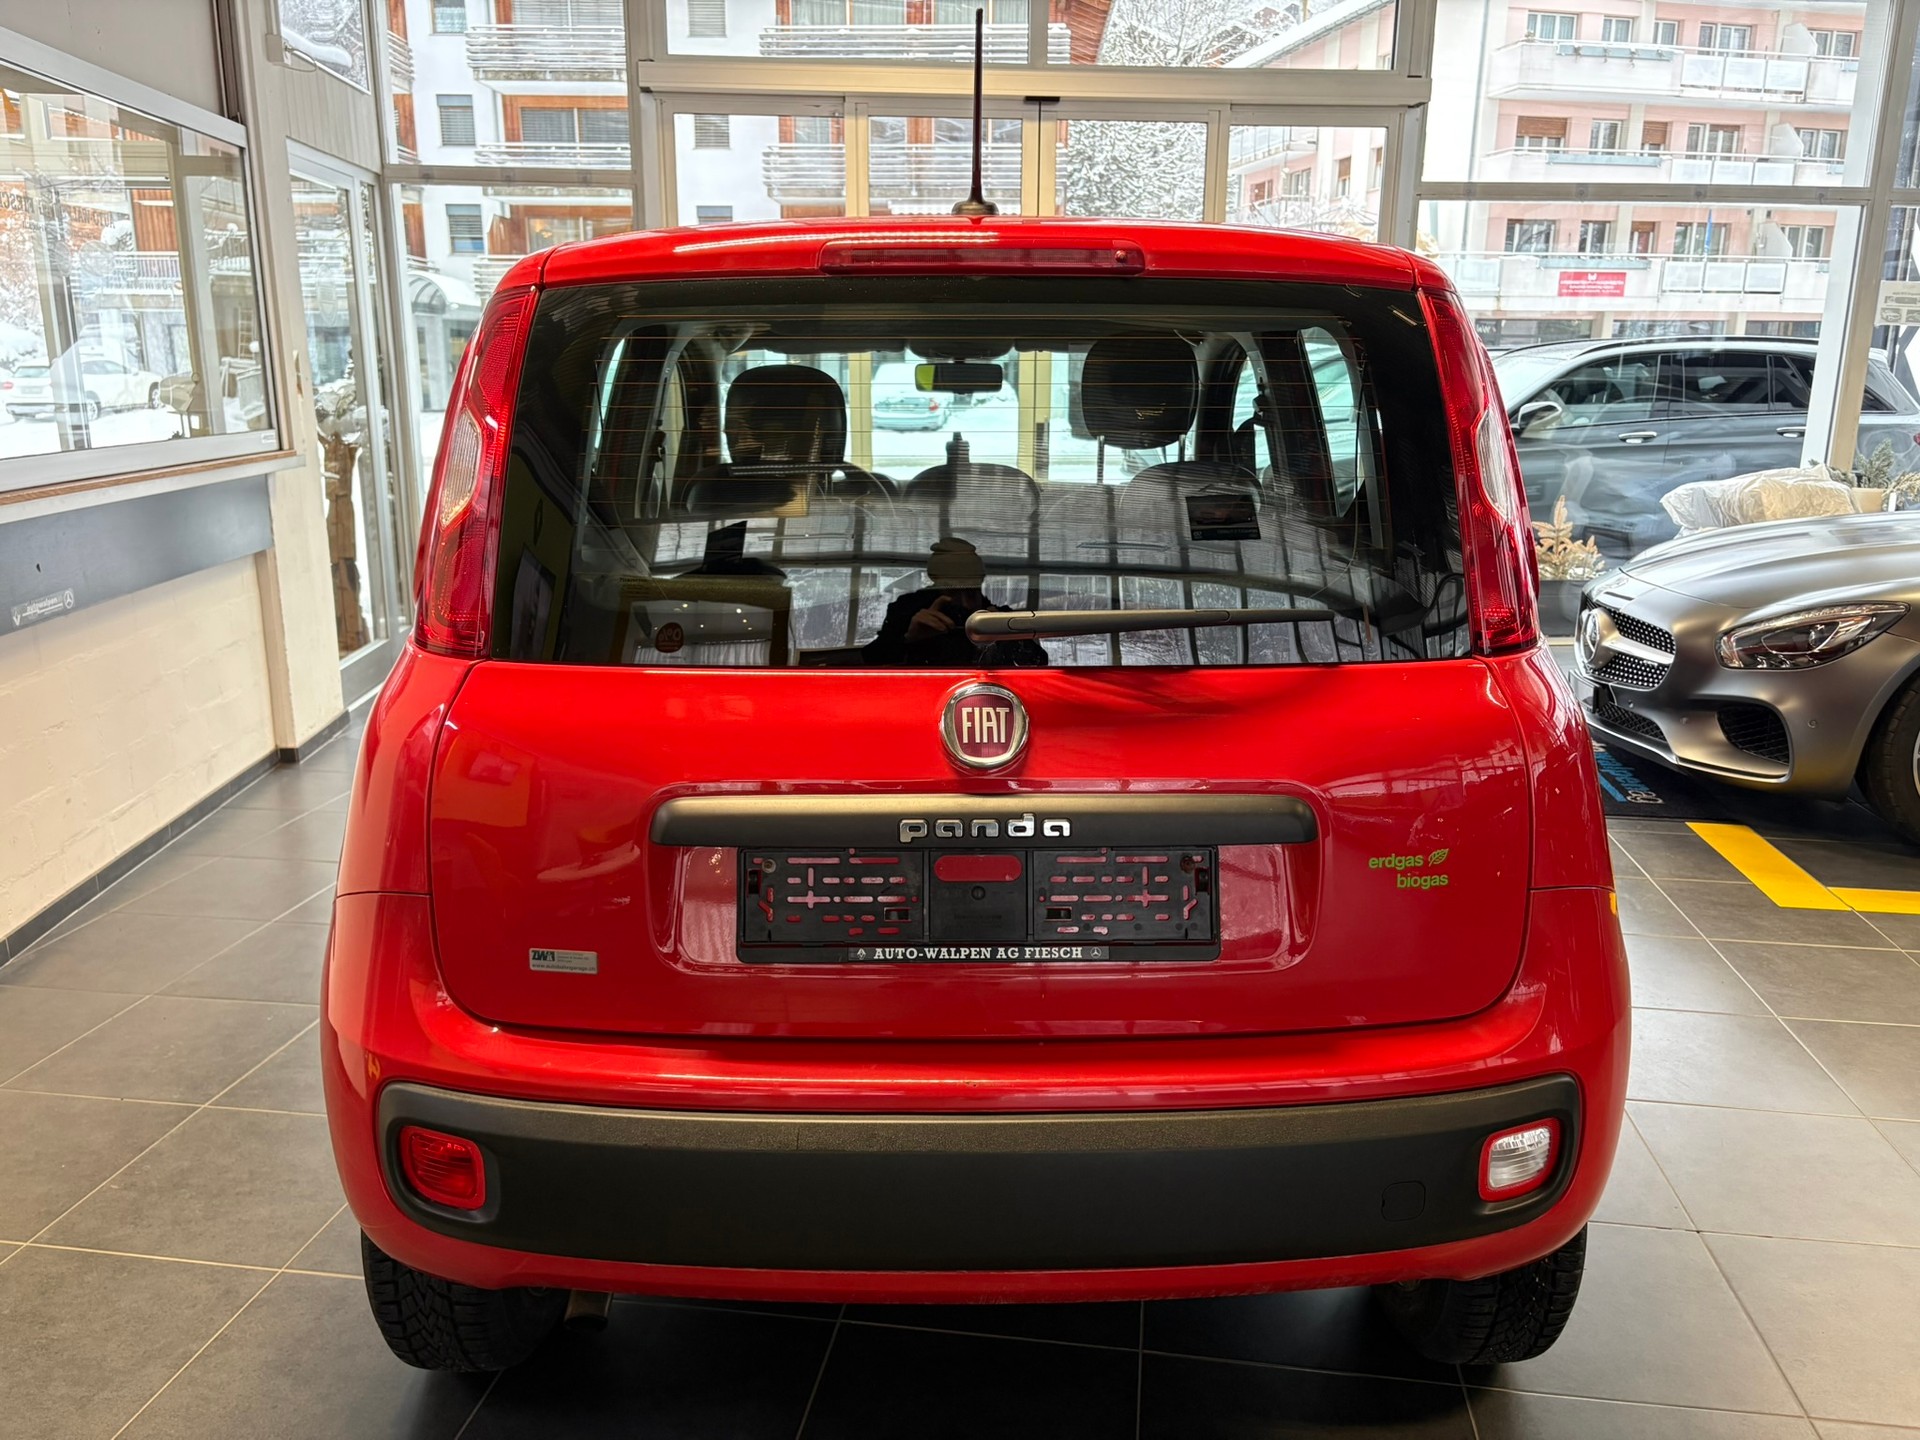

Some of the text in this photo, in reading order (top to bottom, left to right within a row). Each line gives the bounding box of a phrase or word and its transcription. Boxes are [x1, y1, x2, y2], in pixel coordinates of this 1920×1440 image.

[961, 706, 1010, 744] FIAT
[899, 812, 1071, 843] panda
[1368, 853, 1424, 871] erdgas
[1396, 873, 1449, 890] biogas
[873, 946, 1083, 959] AUTO-WALPEN AG FIESCH
